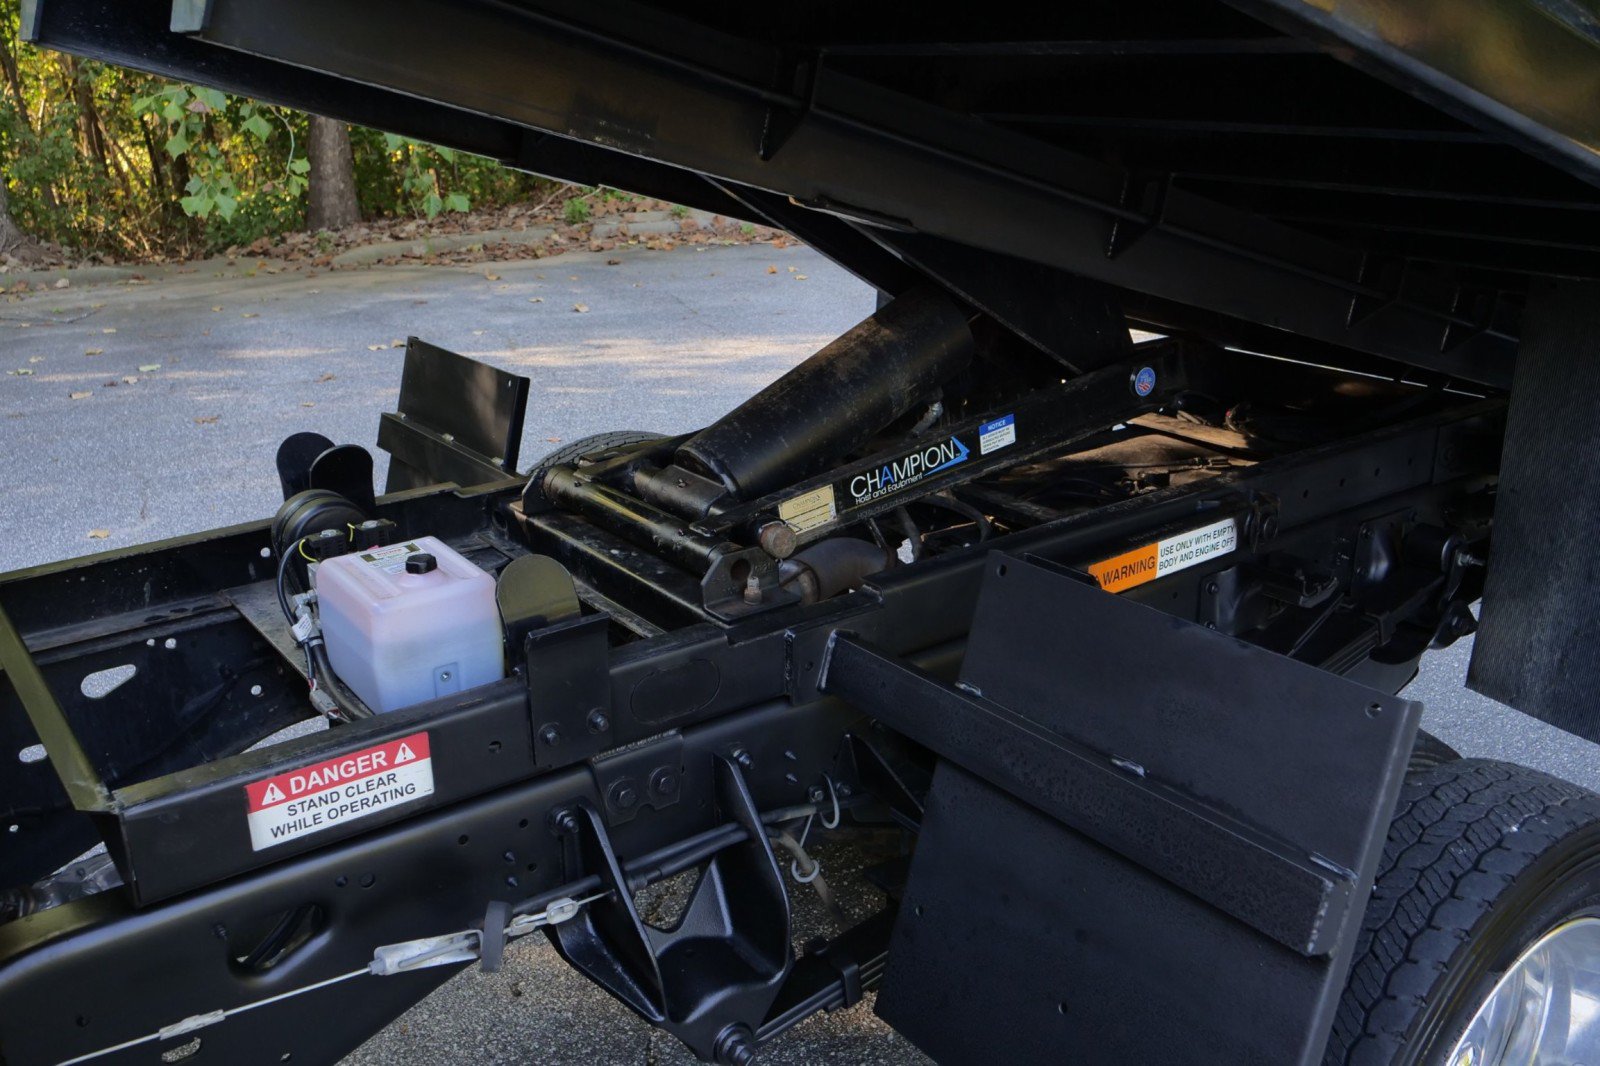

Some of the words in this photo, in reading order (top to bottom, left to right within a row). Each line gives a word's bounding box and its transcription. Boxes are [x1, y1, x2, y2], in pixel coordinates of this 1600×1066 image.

[987, 420, 1006, 430] NOTICE
[850, 440, 954, 497] CHAMPION
[855, 492, 872, 505] Hoist
[873, 487, 887, 498] and
[887, 472, 923, 492] Equipment
[1158, 557, 1178, 571] BODY
[1179, 552, 1194, 563] AND
[1195, 543, 1221, 558] ENGINE
[1221, 536, 1235, 549] OFF
[1160, 545, 1174, 558] USE
[1175, 539, 1194, 552] ONLY
[1194, 533, 1212, 546] WITH
[1213, 525, 1235, 540] EMPTY
[1102, 556, 1155, 586] WARNING
[289, 750, 388, 795] DANGER
[270, 812, 324, 839] WHILE
[327, 782, 417, 821] OPERATING
[287, 790, 340, 817] STAND
[345, 772, 398, 798] CLEAR
